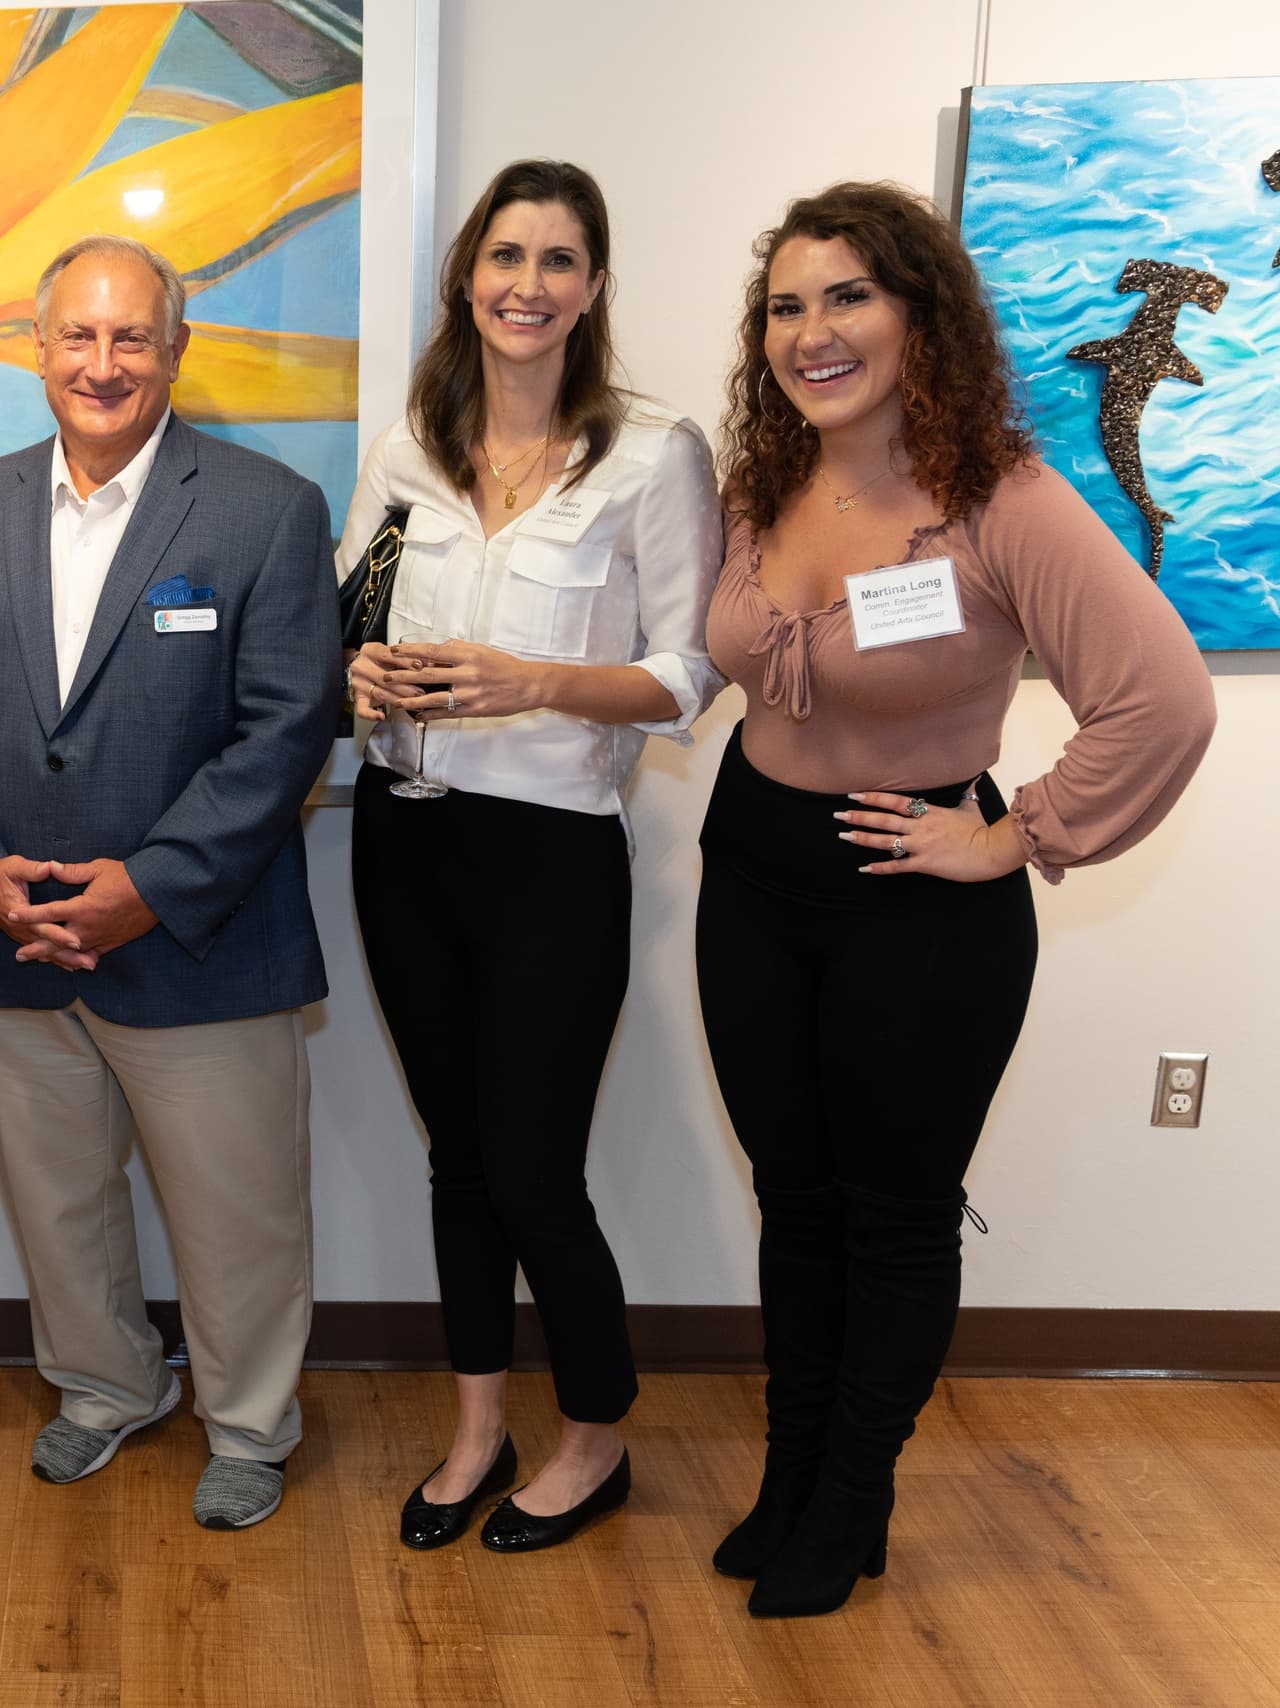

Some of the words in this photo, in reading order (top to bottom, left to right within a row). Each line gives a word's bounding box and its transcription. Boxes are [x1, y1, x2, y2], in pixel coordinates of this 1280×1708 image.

[861, 584, 907, 600] Martina
[909, 578, 942, 591] Long
[894, 590, 944, 606] Engagement
[882, 602, 929, 616] Coordinator
[870, 619, 896, 630] United
[897, 616, 914, 625] Arts
[915, 610, 945, 621] Council
